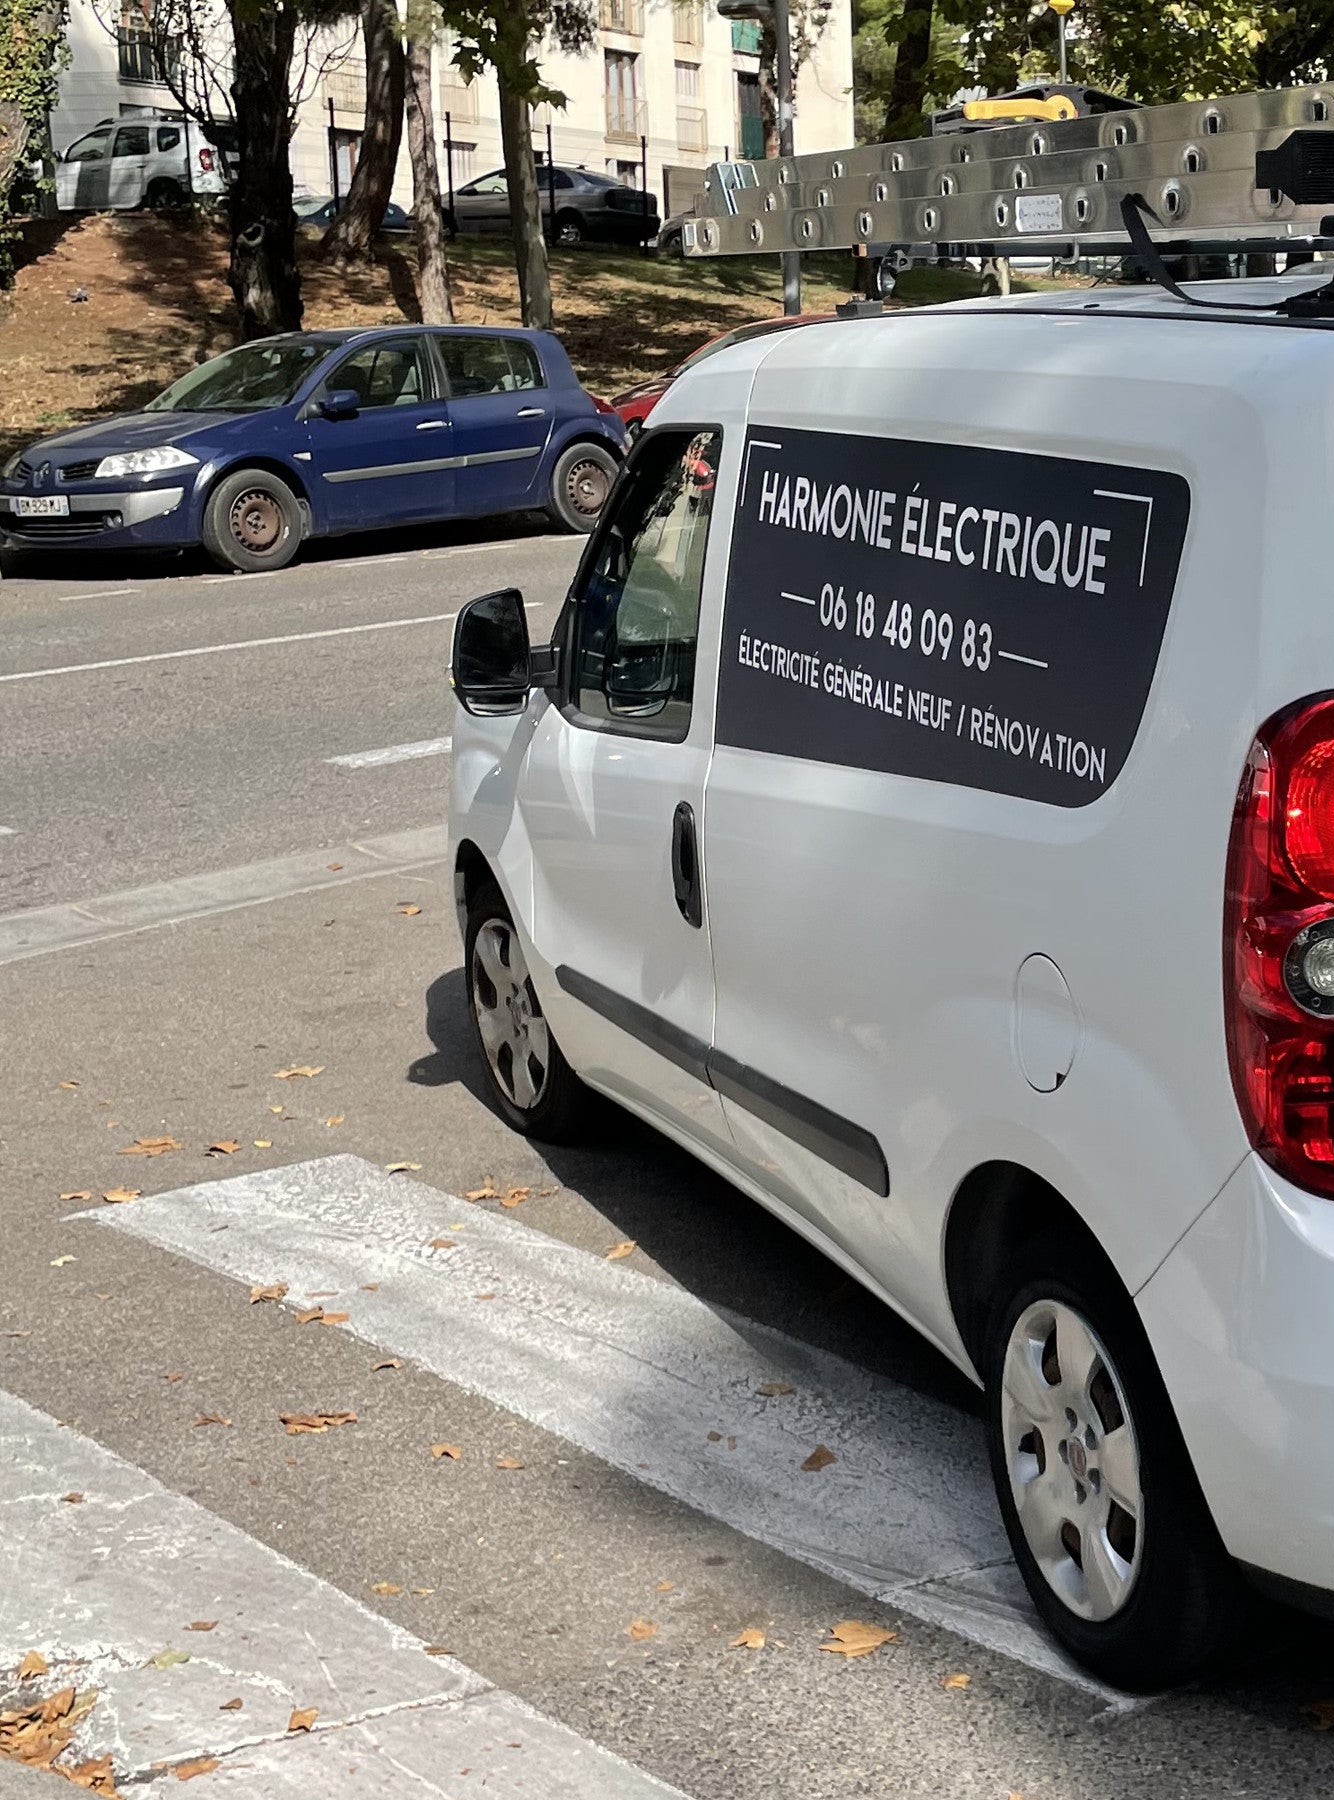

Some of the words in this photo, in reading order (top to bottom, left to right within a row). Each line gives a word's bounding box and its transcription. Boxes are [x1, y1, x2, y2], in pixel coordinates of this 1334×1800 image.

[759, 471, 896, 550] HARMONIE
[901, 482, 1111, 594] ÉLECTRIQUE
[820, 584, 848, 630] 06
[856, 594, 874, 638] 18
[883, 600, 912, 649] 48
[921, 609, 951, 660] 09
[961, 620, 992, 671] 83
[738, 629, 818, 687] ÉLECTRICITÉ
[823, 659, 903, 717] GÉNÉRALE
[907, 693, 951, 730] NEUF
[956, 705, 964, 736] /
[970, 705, 1107, 783] RÉNOVATION
